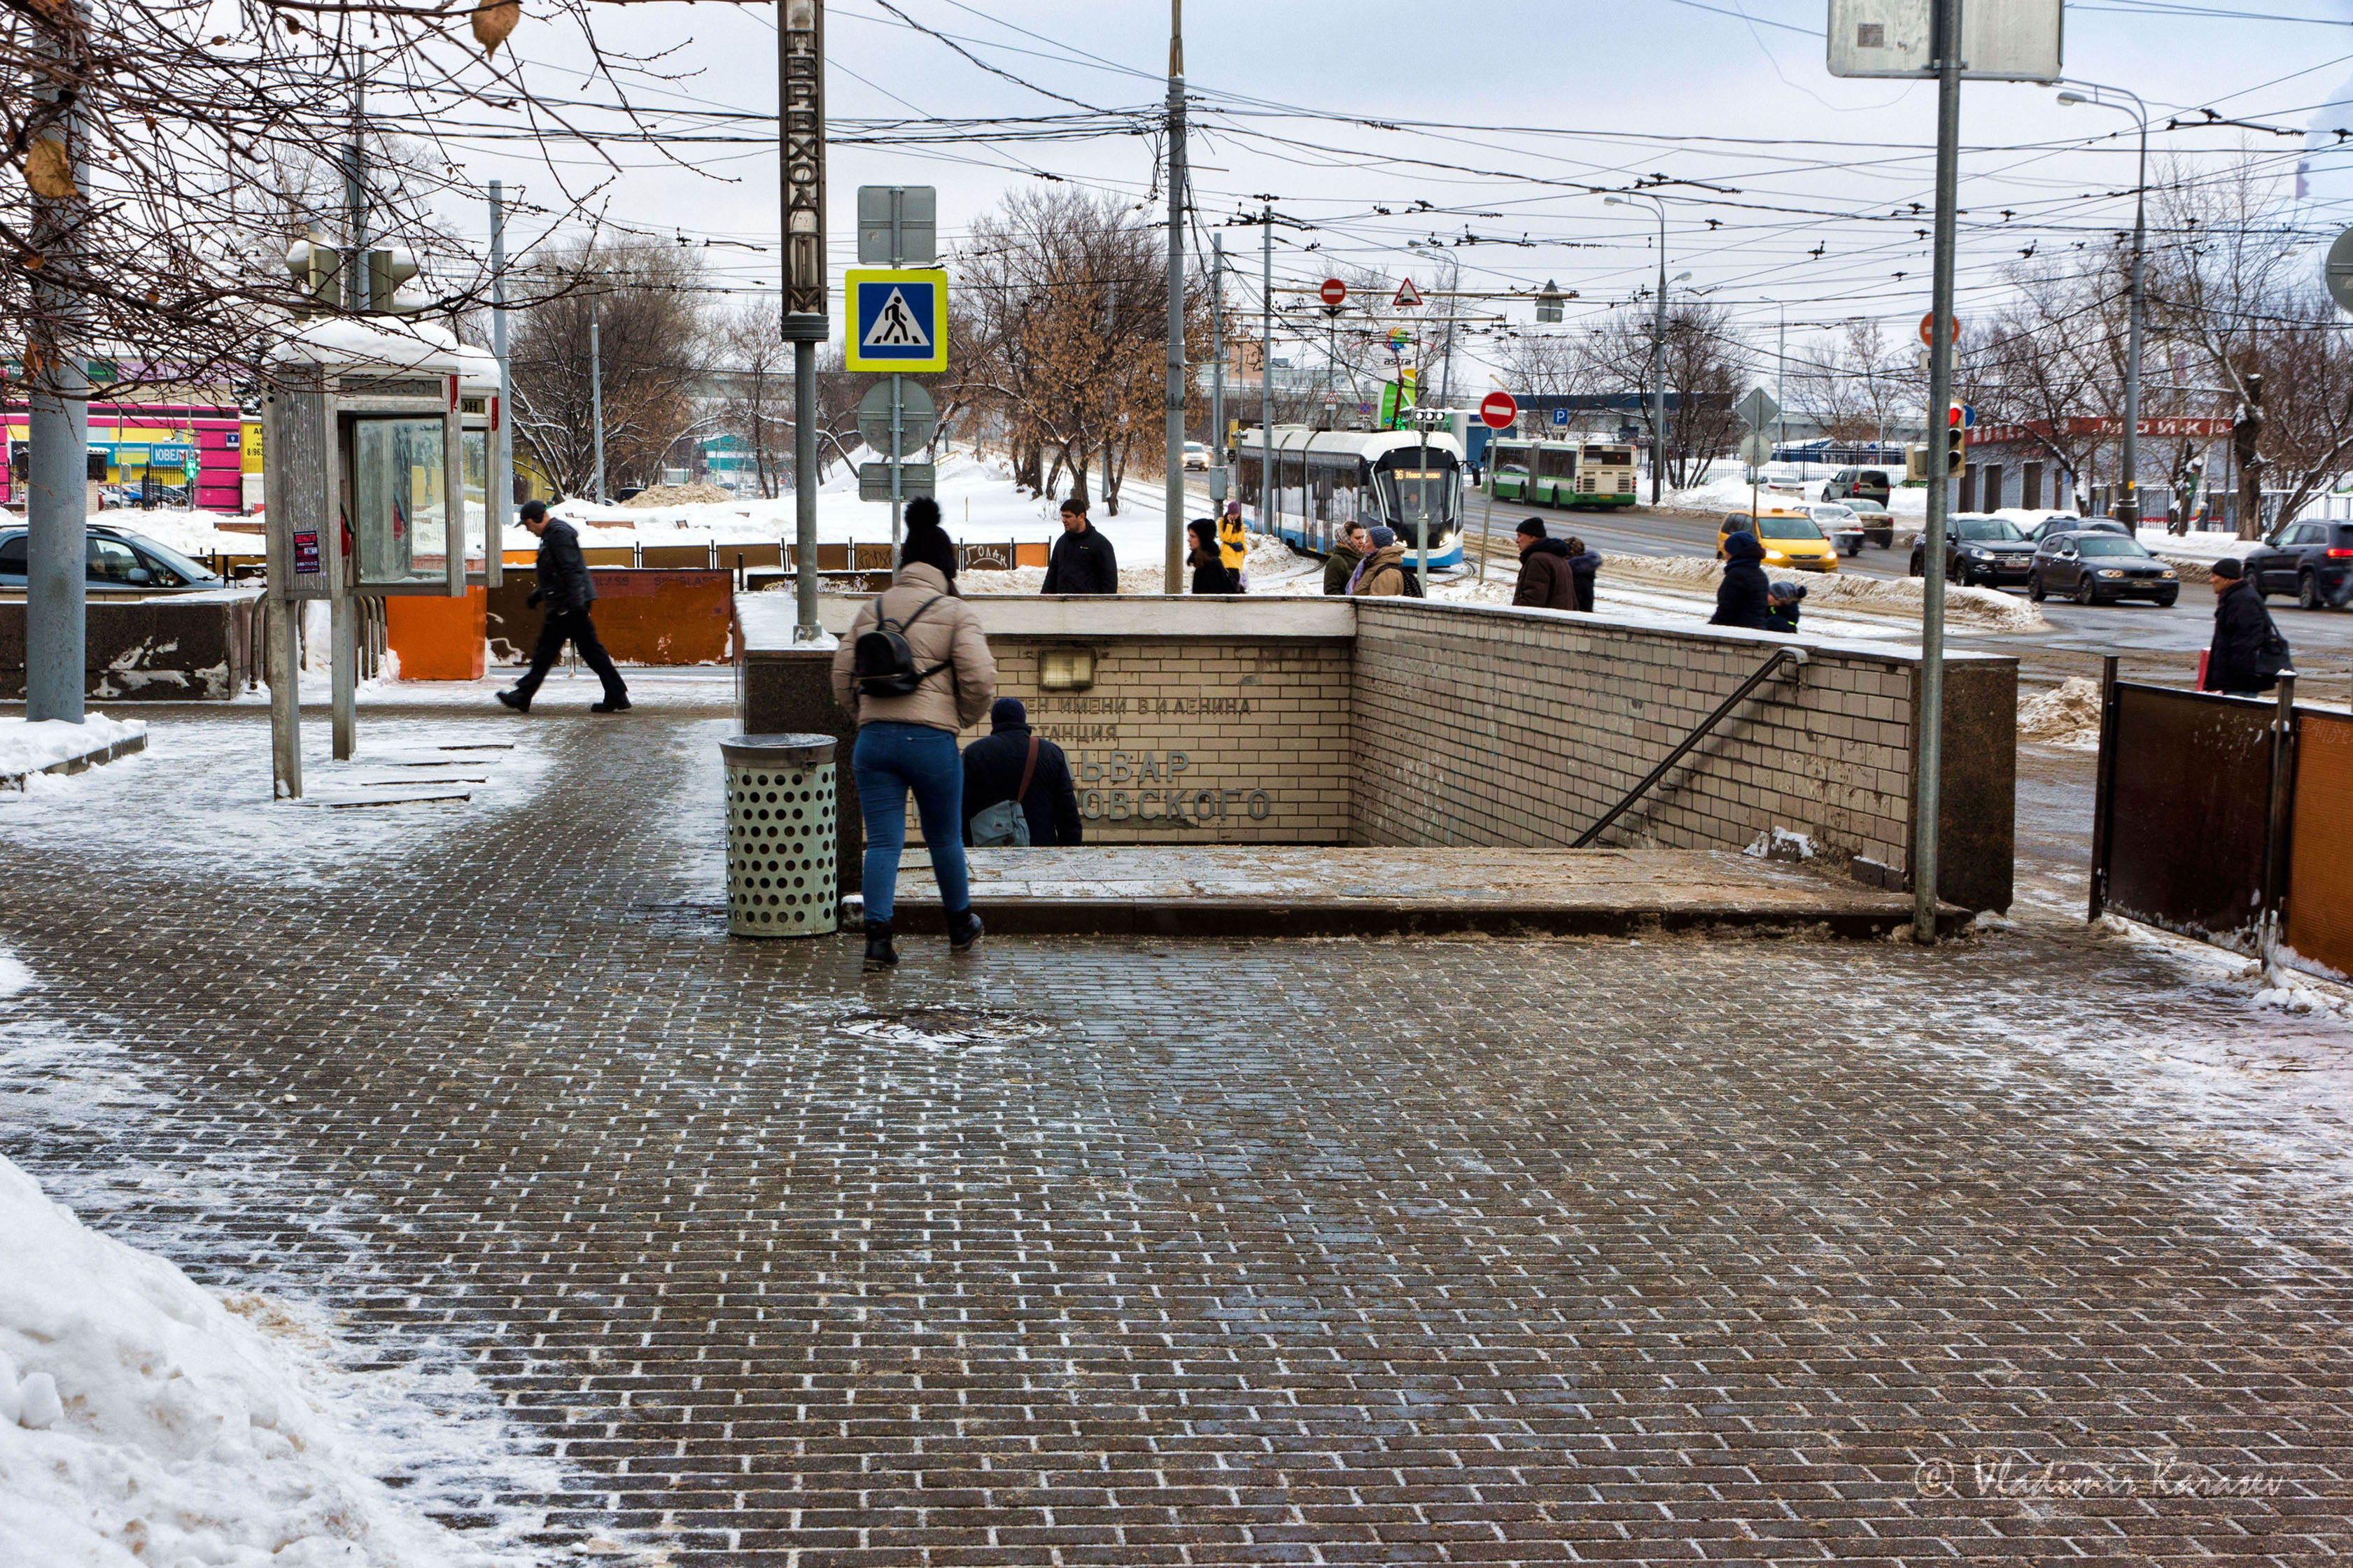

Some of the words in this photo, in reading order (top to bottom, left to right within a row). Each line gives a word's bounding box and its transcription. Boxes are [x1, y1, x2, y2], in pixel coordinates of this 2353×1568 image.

[785, 29, 819, 212] ПЕРЕХОД
[1394, 469, 1404, 480] 36
[1058, 698, 1127, 714] ИМЕНИ
[1138, 698, 1149, 714] В
[1174, 698, 1251, 714] ЛЕНИНА
